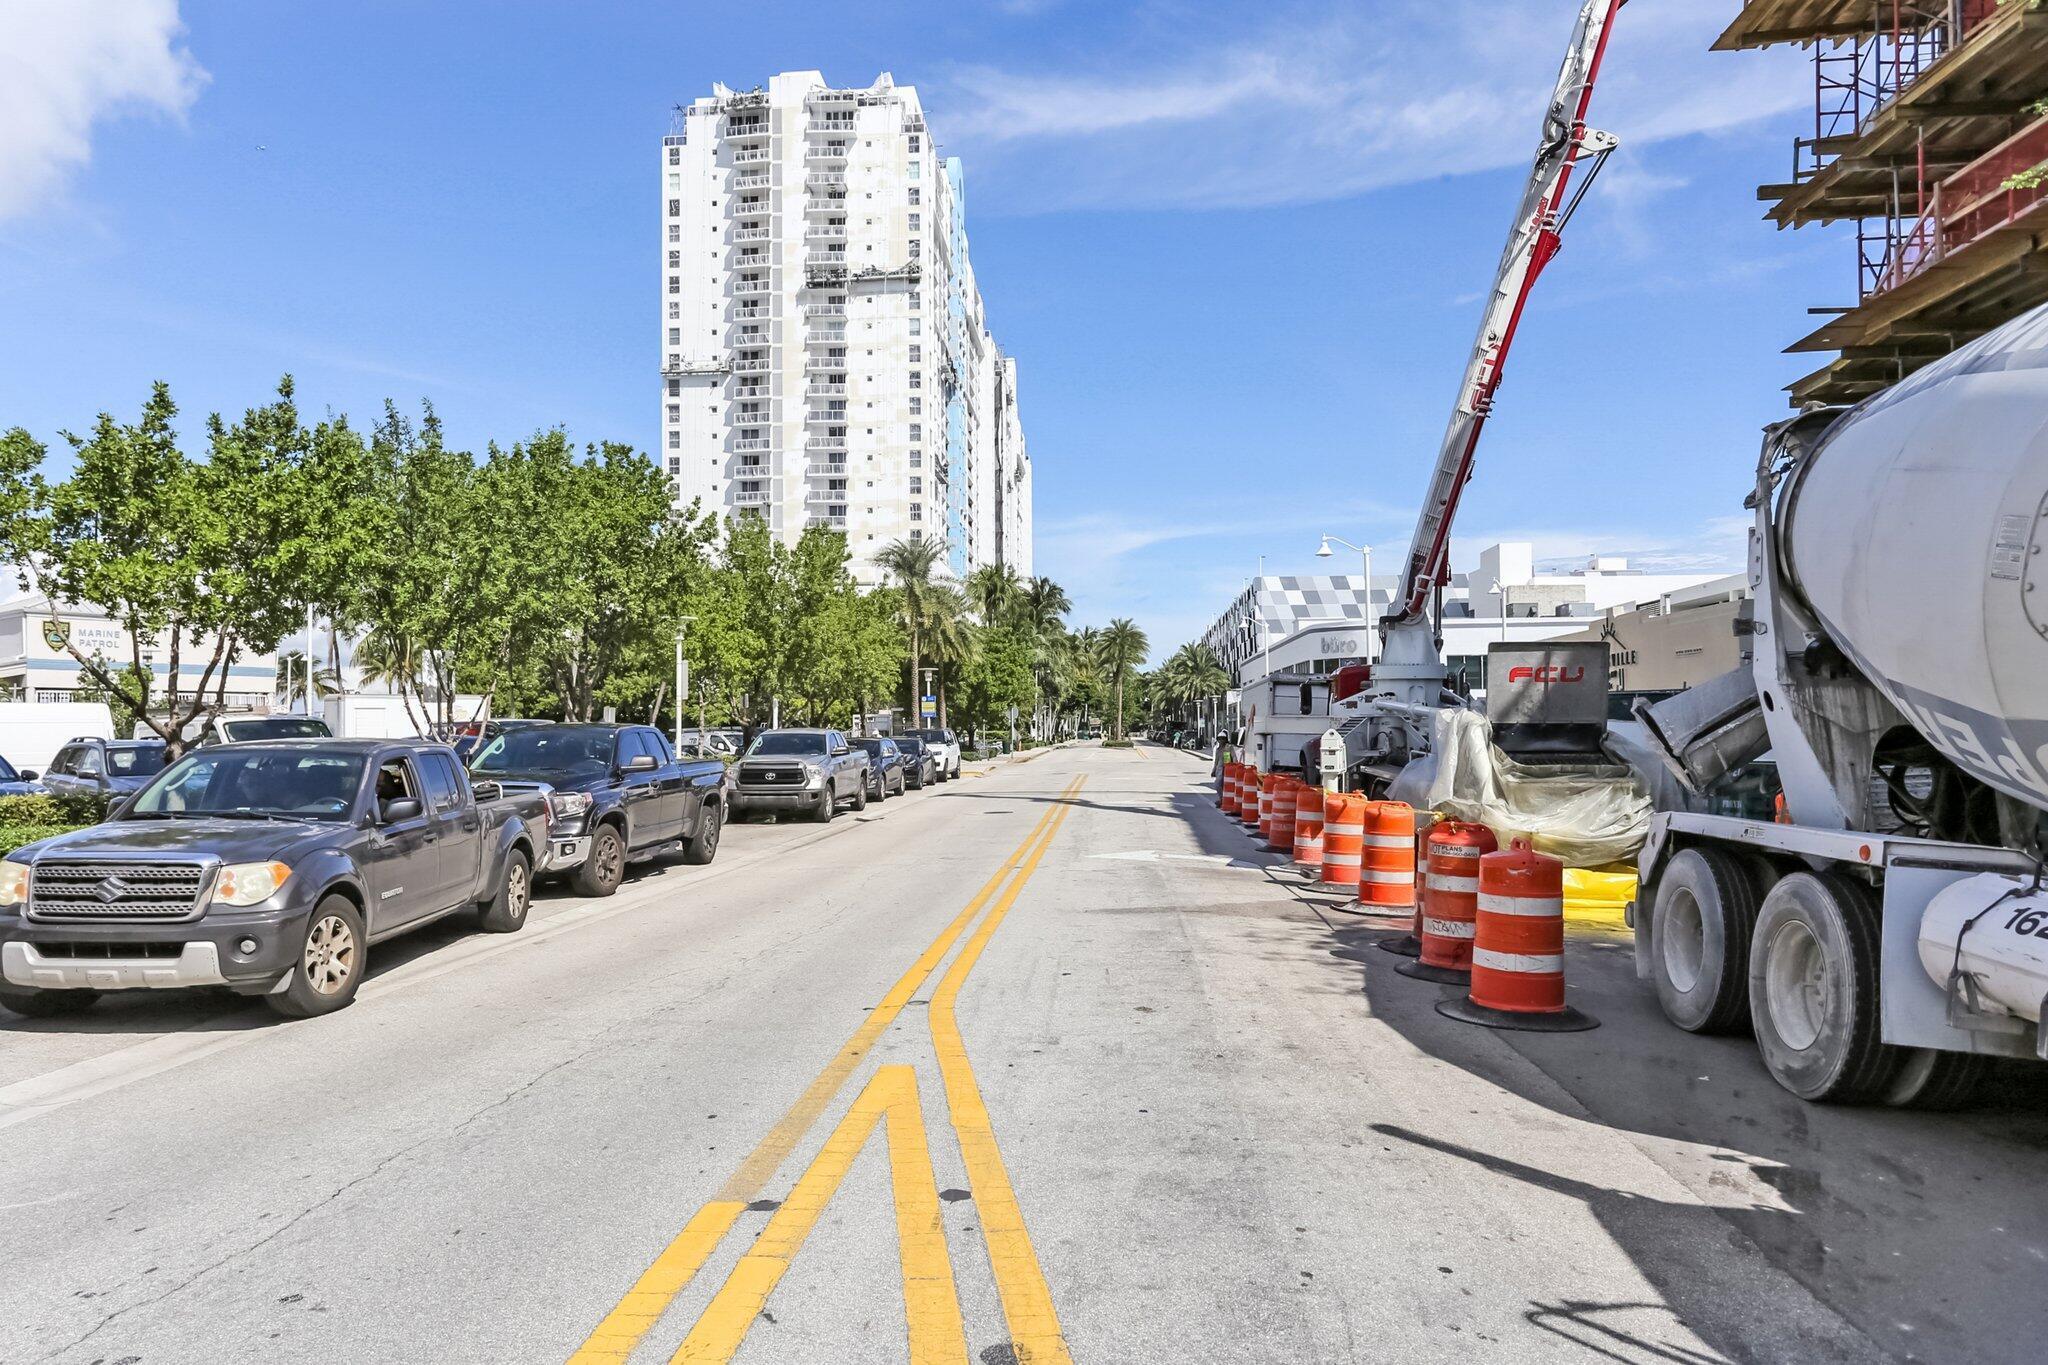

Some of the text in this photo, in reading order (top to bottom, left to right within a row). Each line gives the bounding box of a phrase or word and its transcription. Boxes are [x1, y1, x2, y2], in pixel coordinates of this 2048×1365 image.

[78, 629, 120, 638] MARINE
[79, 639, 120, 649] PATROL
[1321, 636, 1358, 653] büro
[1611, 650, 1636, 666] VILLE
[1508, 667, 1585, 682] FCU
